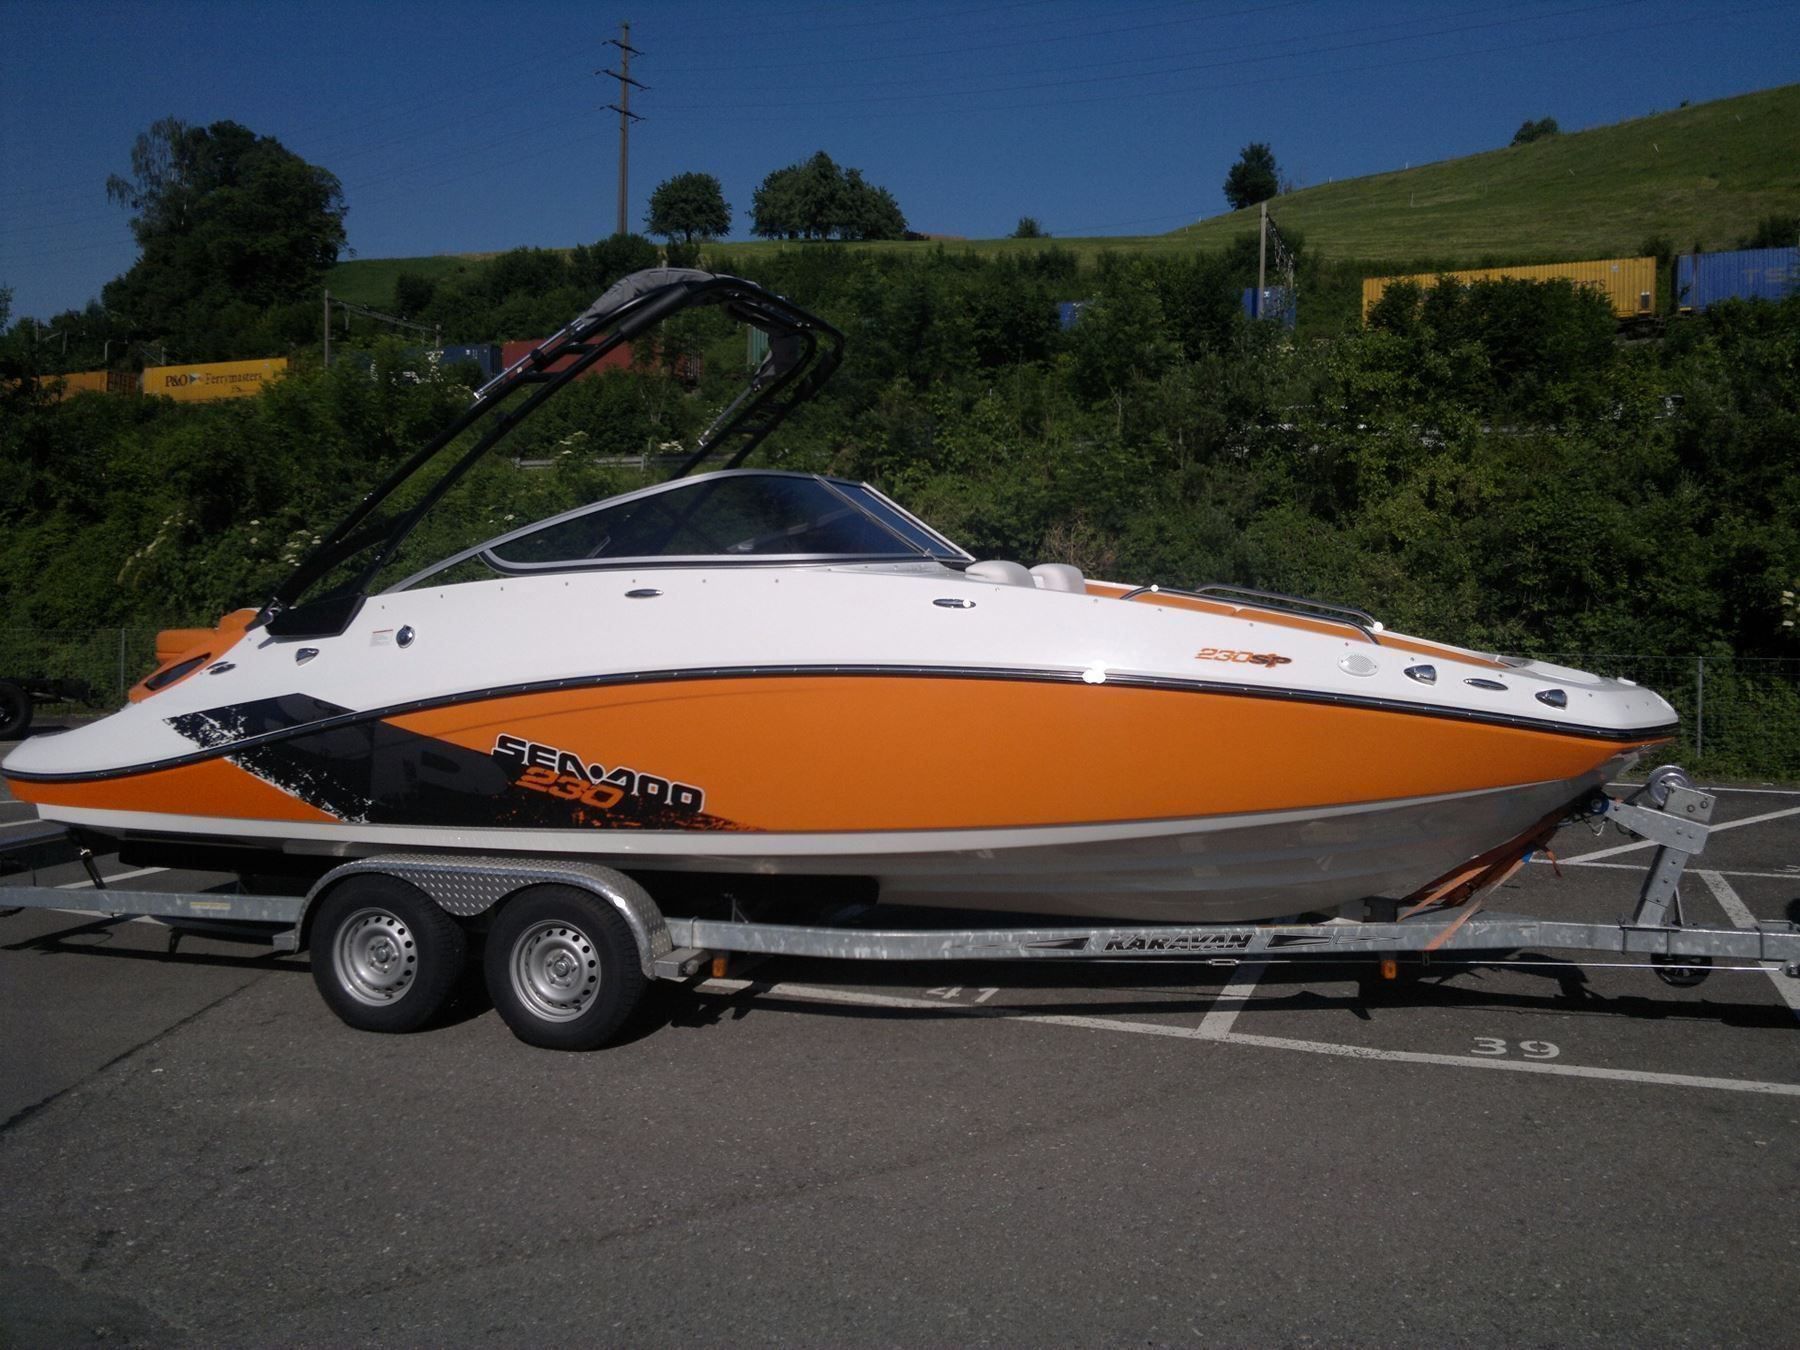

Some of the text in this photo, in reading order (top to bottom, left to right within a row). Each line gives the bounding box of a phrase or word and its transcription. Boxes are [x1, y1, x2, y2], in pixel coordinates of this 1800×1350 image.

[165, 374, 188, 388] P&O
[514, 766, 625, 809] 230
[1104, 933, 1255, 951] KARAVAN
[1470, 1036, 1560, 1059] 39
